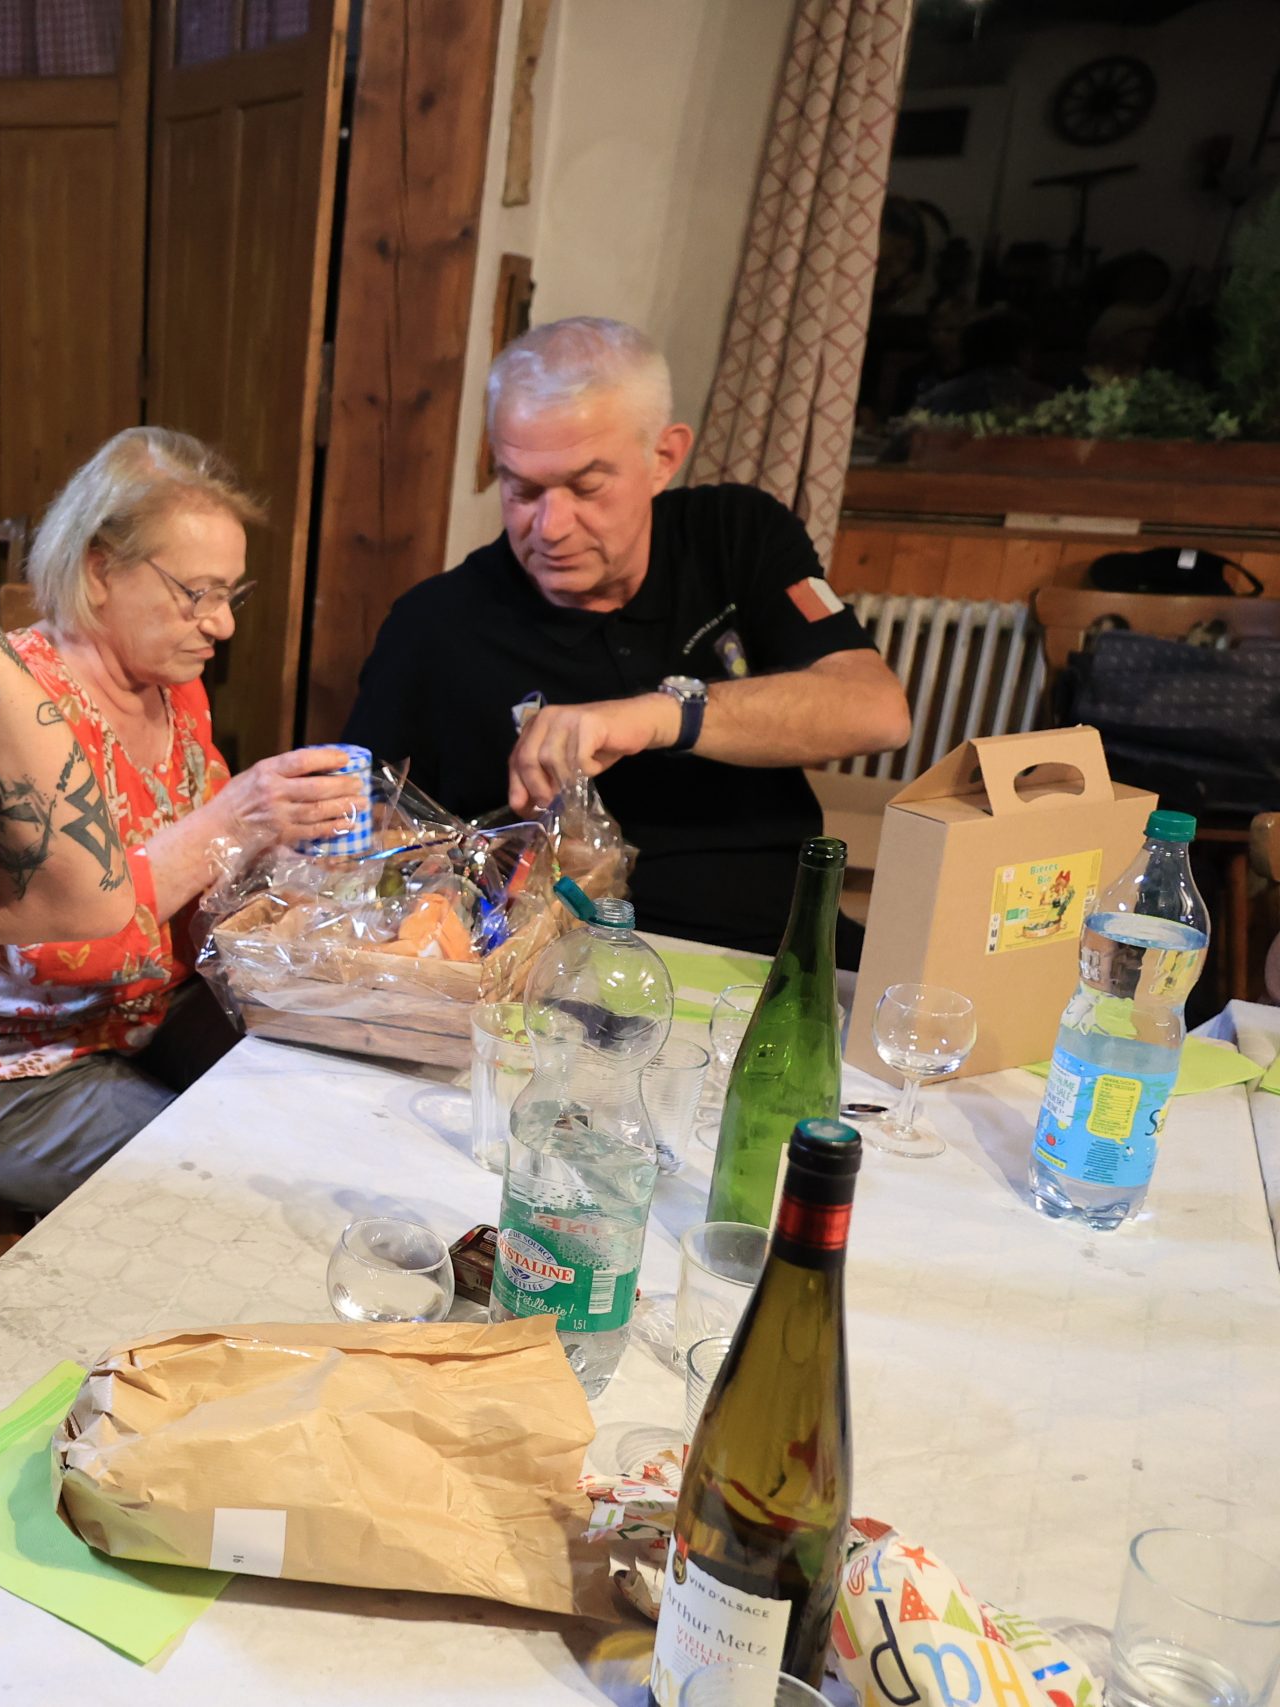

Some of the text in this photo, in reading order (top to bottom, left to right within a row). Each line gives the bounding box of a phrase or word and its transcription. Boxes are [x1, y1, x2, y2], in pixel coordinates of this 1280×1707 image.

[498, 1237, 572, 1282] RISTALINE
[513, 1230, 522, 1240] DE
[523, 1235, 553, 1263] SOURCE
[689, 1575, 770, 1618] VIN D'ALSACE
[666, 1586, 768, 1656] Arthur Metz
